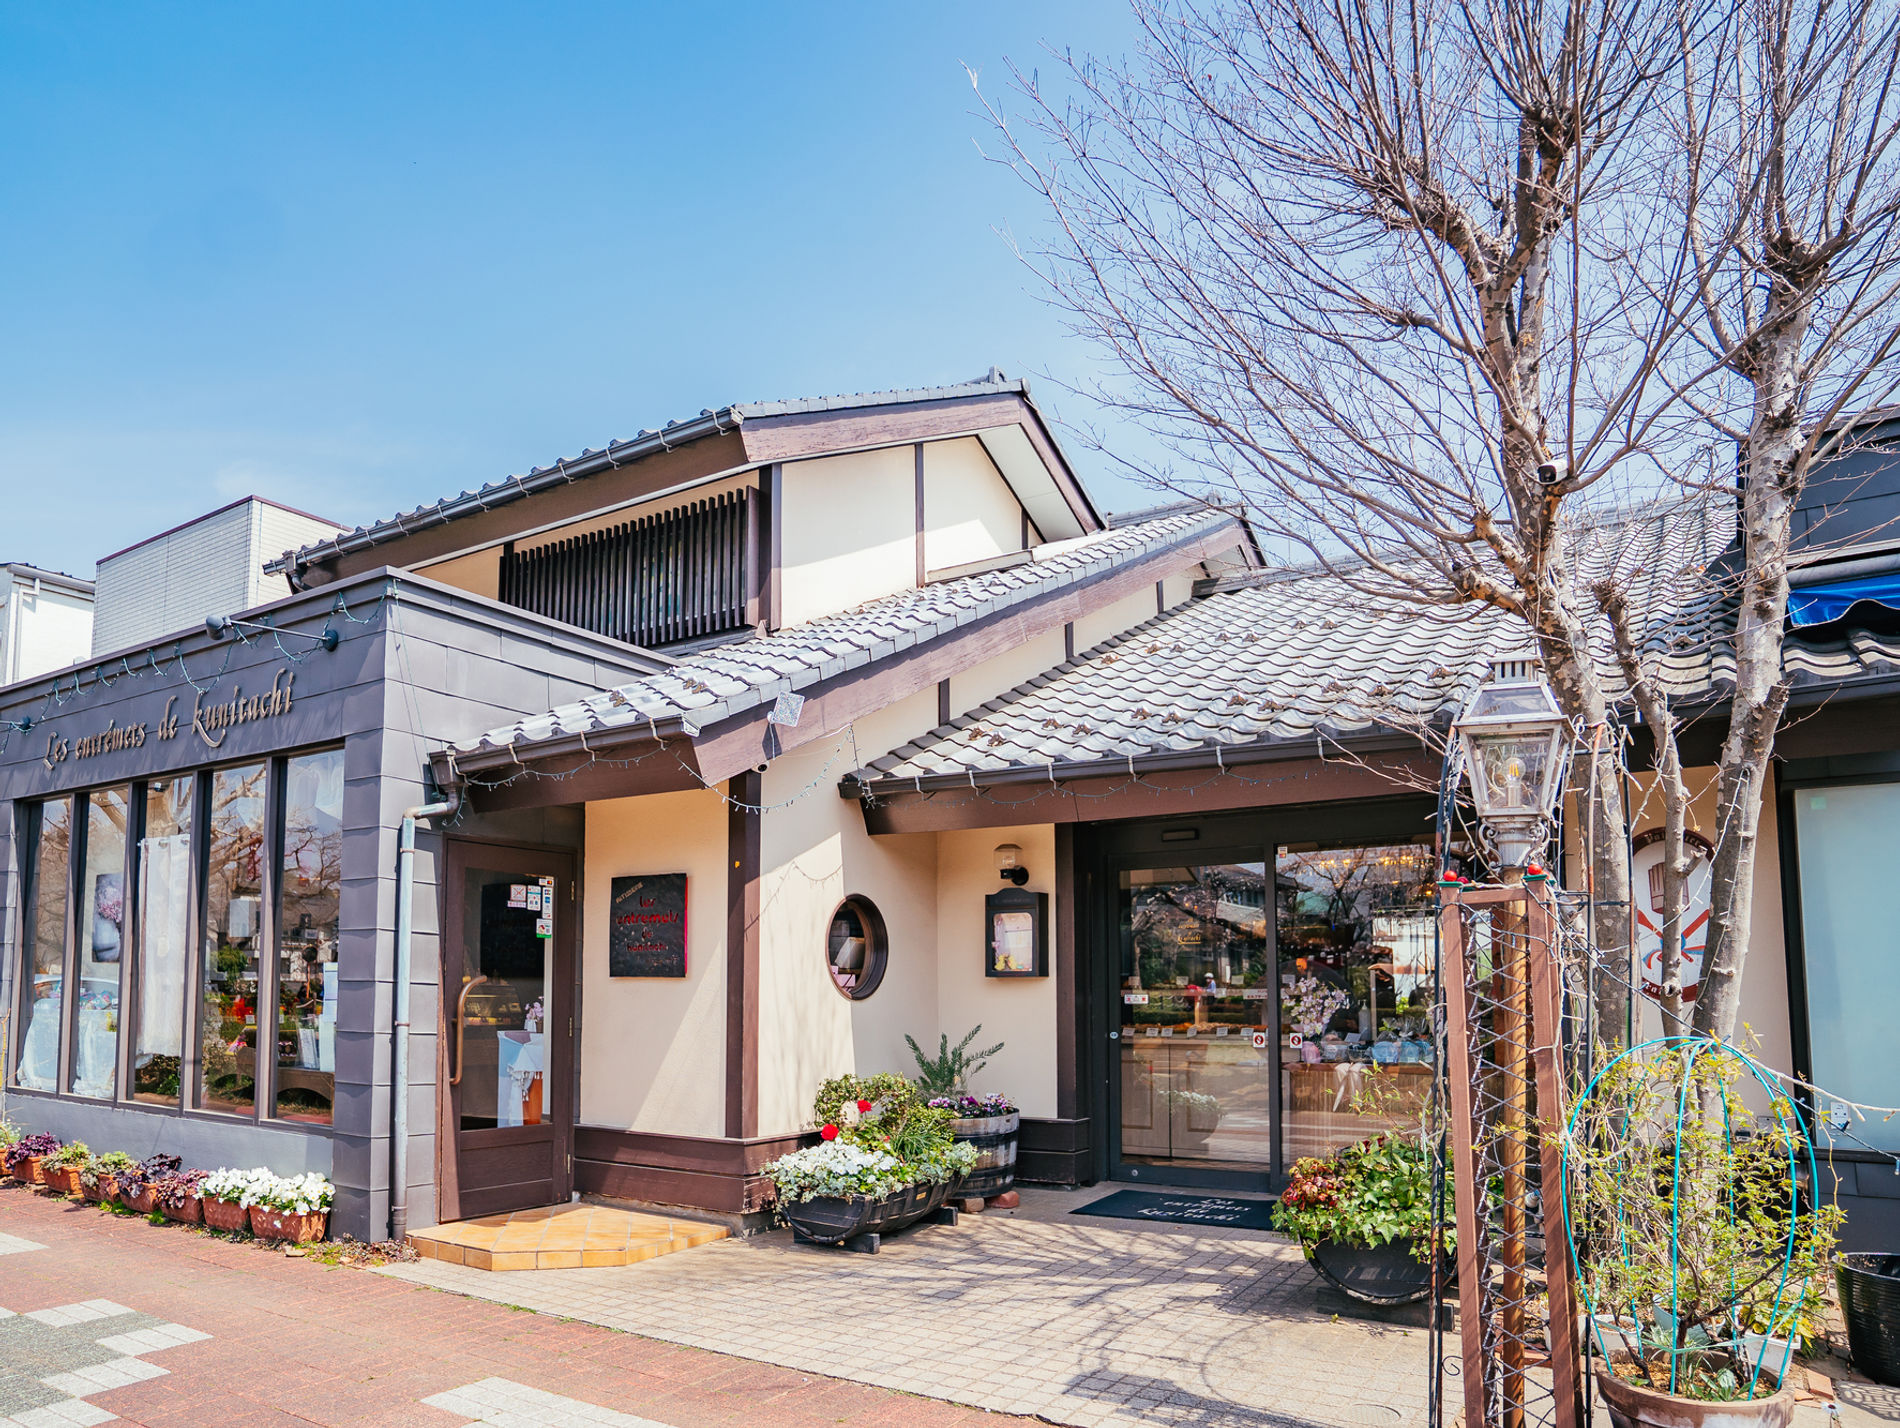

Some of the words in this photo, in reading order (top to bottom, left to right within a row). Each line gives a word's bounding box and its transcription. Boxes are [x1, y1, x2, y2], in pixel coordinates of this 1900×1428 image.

[43, 731, 69, 770] Les
[75, 719, 147, 760] entremets
[158, 695, 178, 740] de
